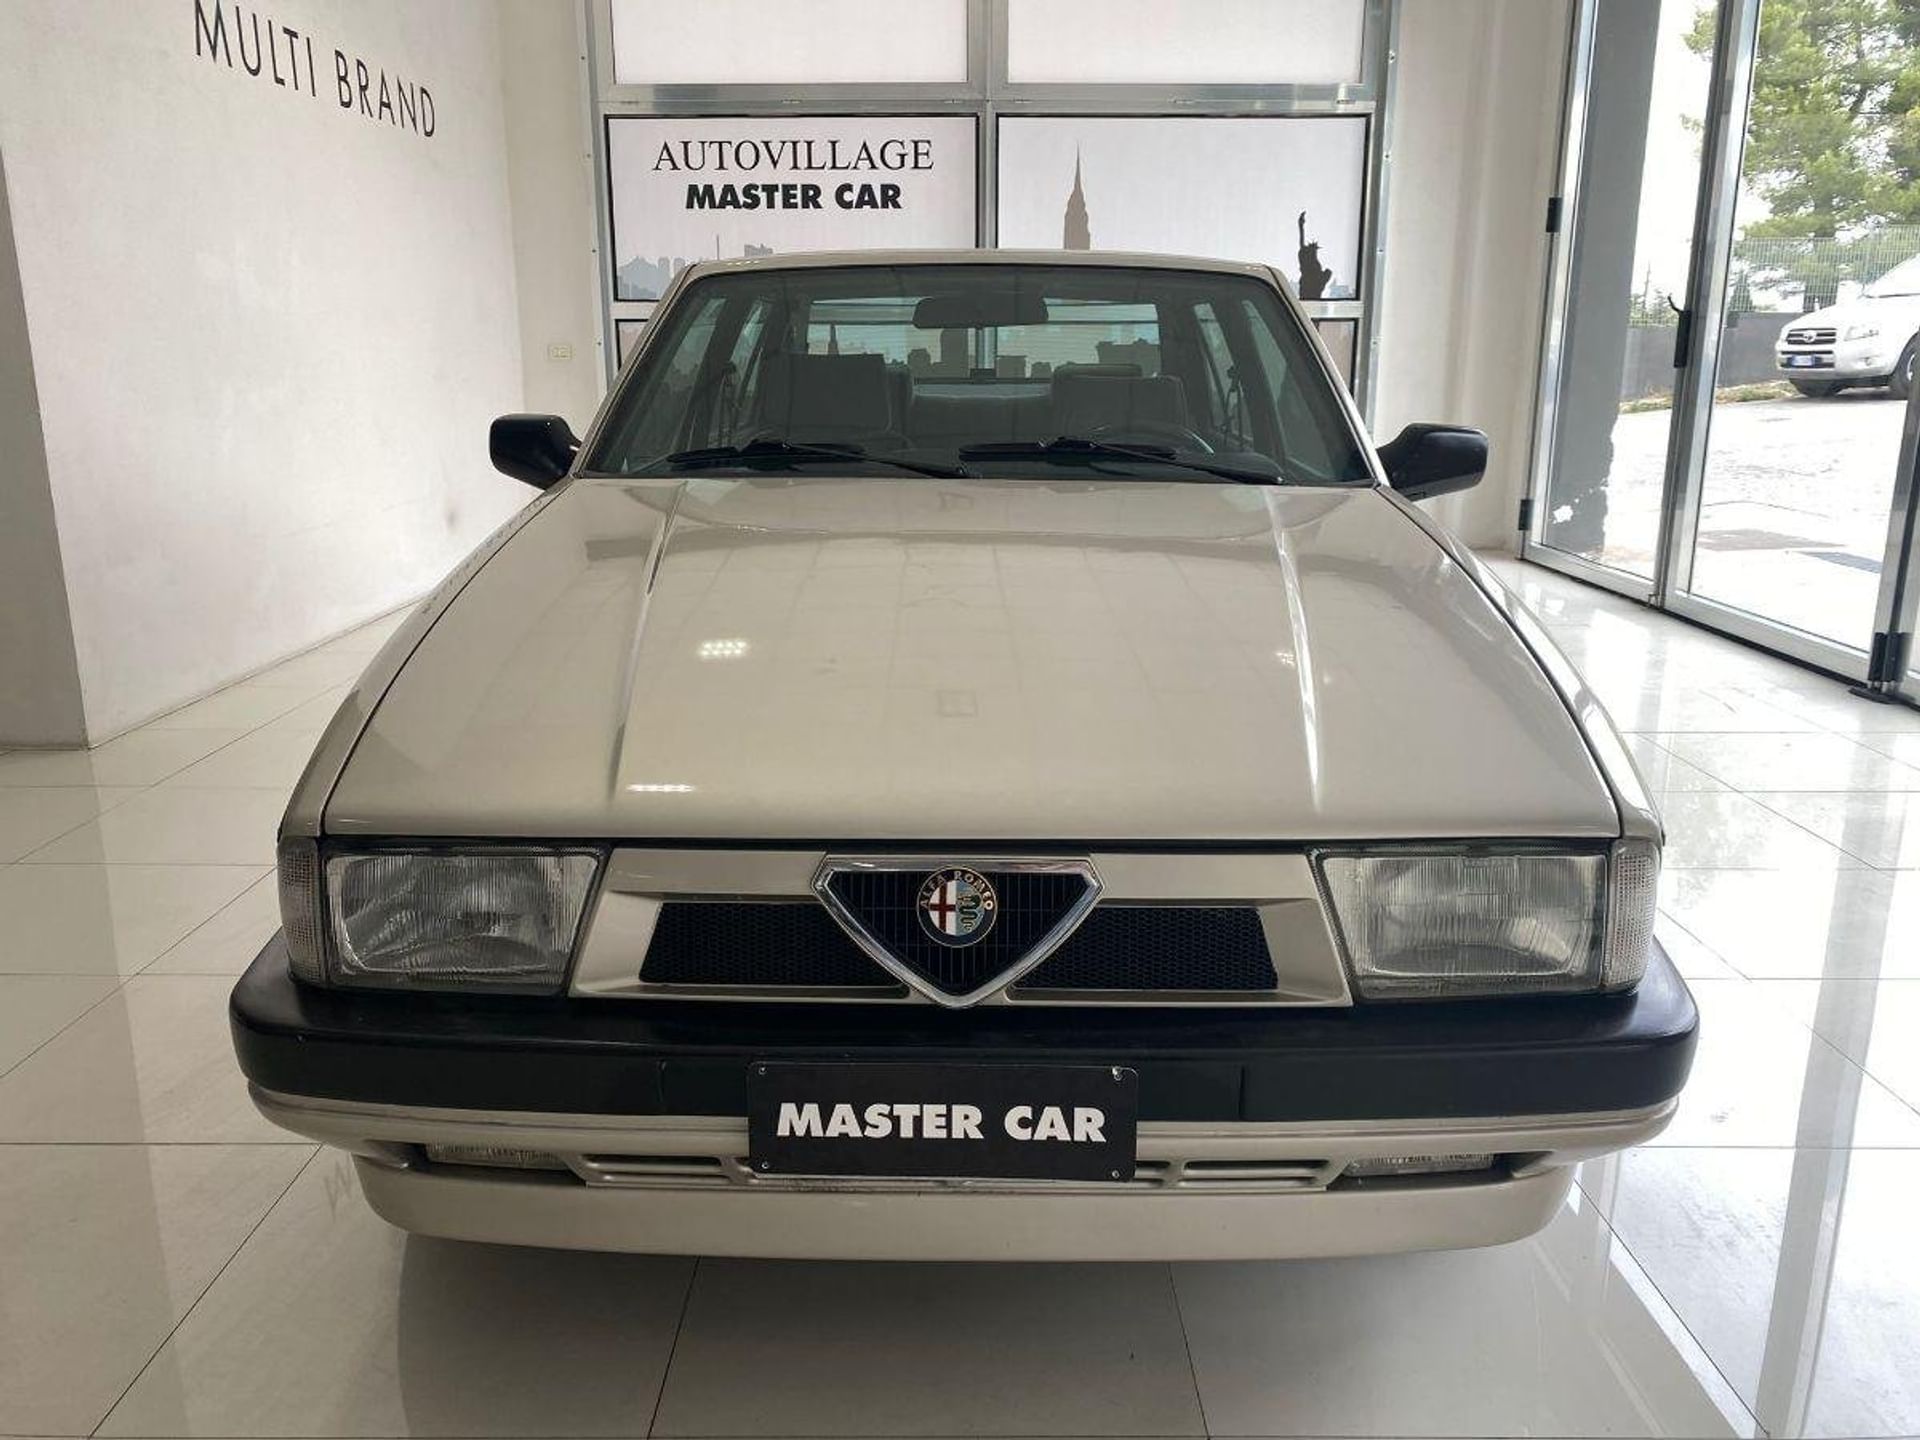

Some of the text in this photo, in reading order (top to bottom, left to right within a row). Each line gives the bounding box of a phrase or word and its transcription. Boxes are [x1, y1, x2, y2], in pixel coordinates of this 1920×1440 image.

[194, 0, 436, 138] MULTI BRAND
[652, 139, 935, 171] AUTOVILLAGE
[685, 183, 902, 210] MASTER CAR
[920, 870, 994, 911] ALFA ROMEO
[776, 1102, 1107, 1143] MASTER CAR
